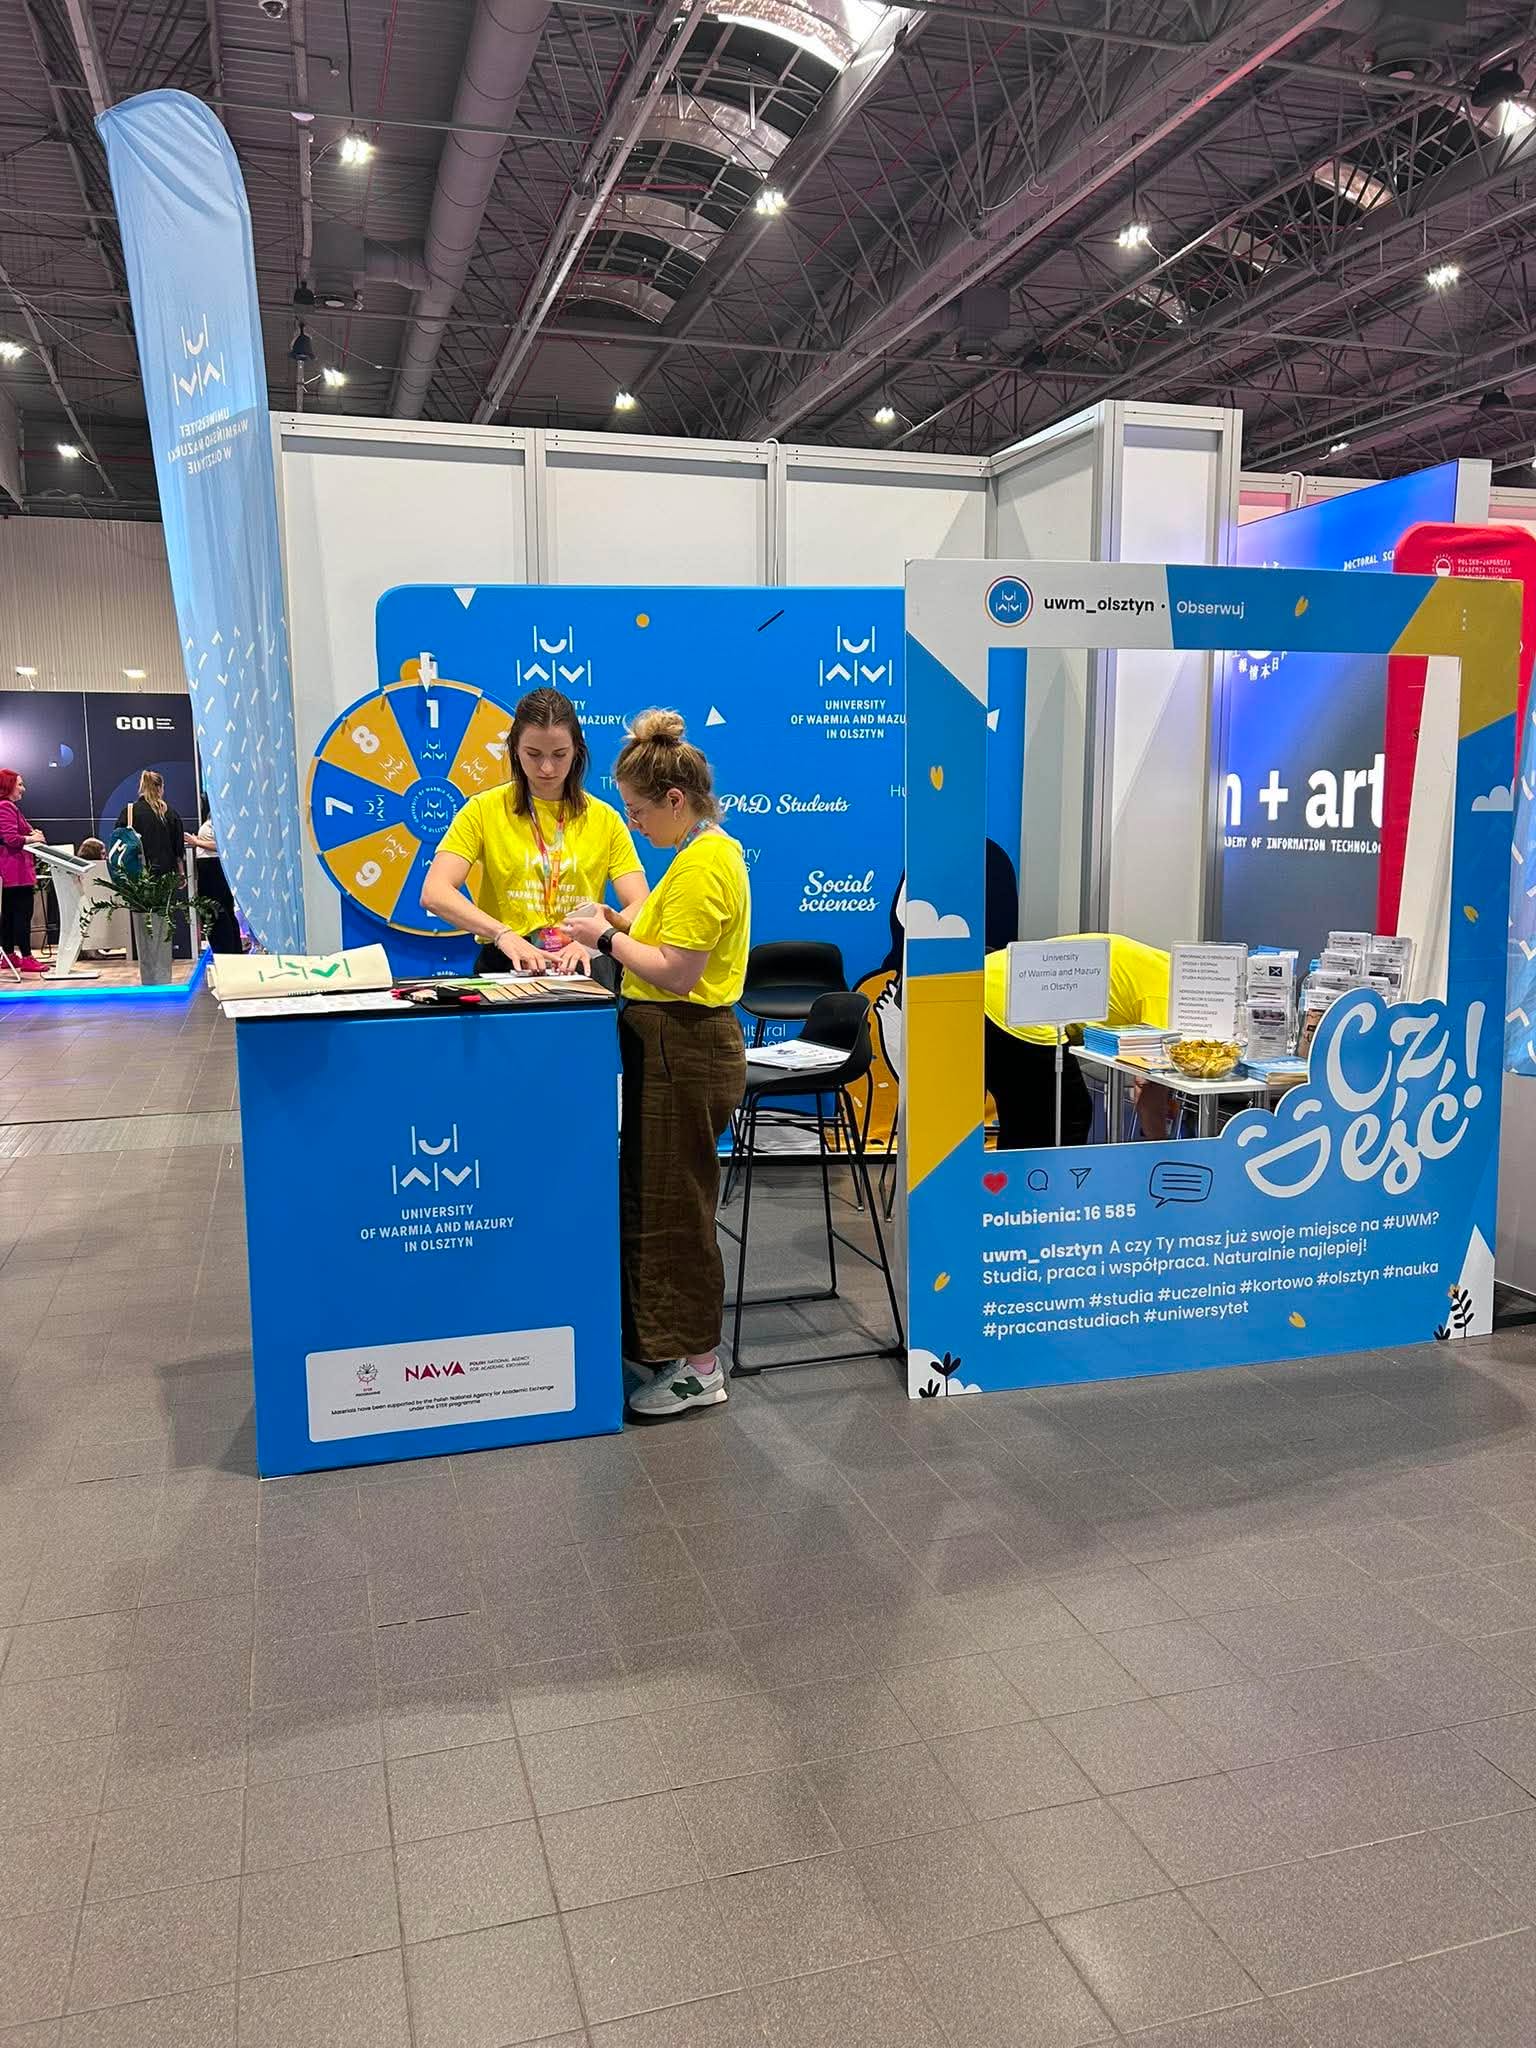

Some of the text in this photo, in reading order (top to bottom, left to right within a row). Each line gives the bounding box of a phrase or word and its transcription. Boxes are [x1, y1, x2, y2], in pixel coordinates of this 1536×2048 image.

[1044, 596, 1246, 620] uwm_olsztyn Obserwuj
[426, 699, 439, 728] 1
[825, 700, 886, 710] UNIVERSITY
[116, 716, 154, 730] COI
[791, 714, 906, 724] OF WARMIA AND MAZU
[352, 726, 380, 754] 8
[826, 728, 884, 738] IN OLSZTYN
[325, 796, 354, 816] 7
[719, 794, 851, 814] PhD Students
[1224, 837, 1382, 854] ADEMY OF INFORMATION TECHNOLO
[804, 870, 874, 896] Social
[799, 892, 880, 912] sciences
[1042, 953, 1080, 962] University
[1018, 966, 1102, 978] of Warmia and Mazury
[1041, 982, 1078, 992] in Olsztyn
[402, 1204, 474, 1220] UNIVERSITY
[982, 1203, 1136, 1228] Polubienia: 16 585
[360, 1217, 514, 1240] OF WARMIA AND MAZURY
[982, 1212, 1440, 1264] uwm_olsztyn A czy Ty masz już swoje miejsce na #UWM?
[404, 1236, 474, 1252] IN OLSZTYN
[982, 1238, 1368, 1285] Studia, praca i współpraca. Naturalnie najlepiej!
[982, 1261, 1439, 1316] #czescuwm #studia #uczelnia #kortowo #olsztyn #nauka
[982, 1300, 1248, 1340] #pracanastudiach #uniwersytet
[405, 1360, 466, 1382] NAWA
[387, 1400, 415, 1410] supported
[529, 1384, 554, 1392] Exchange
[448, 1399, 480, 1408] programme
